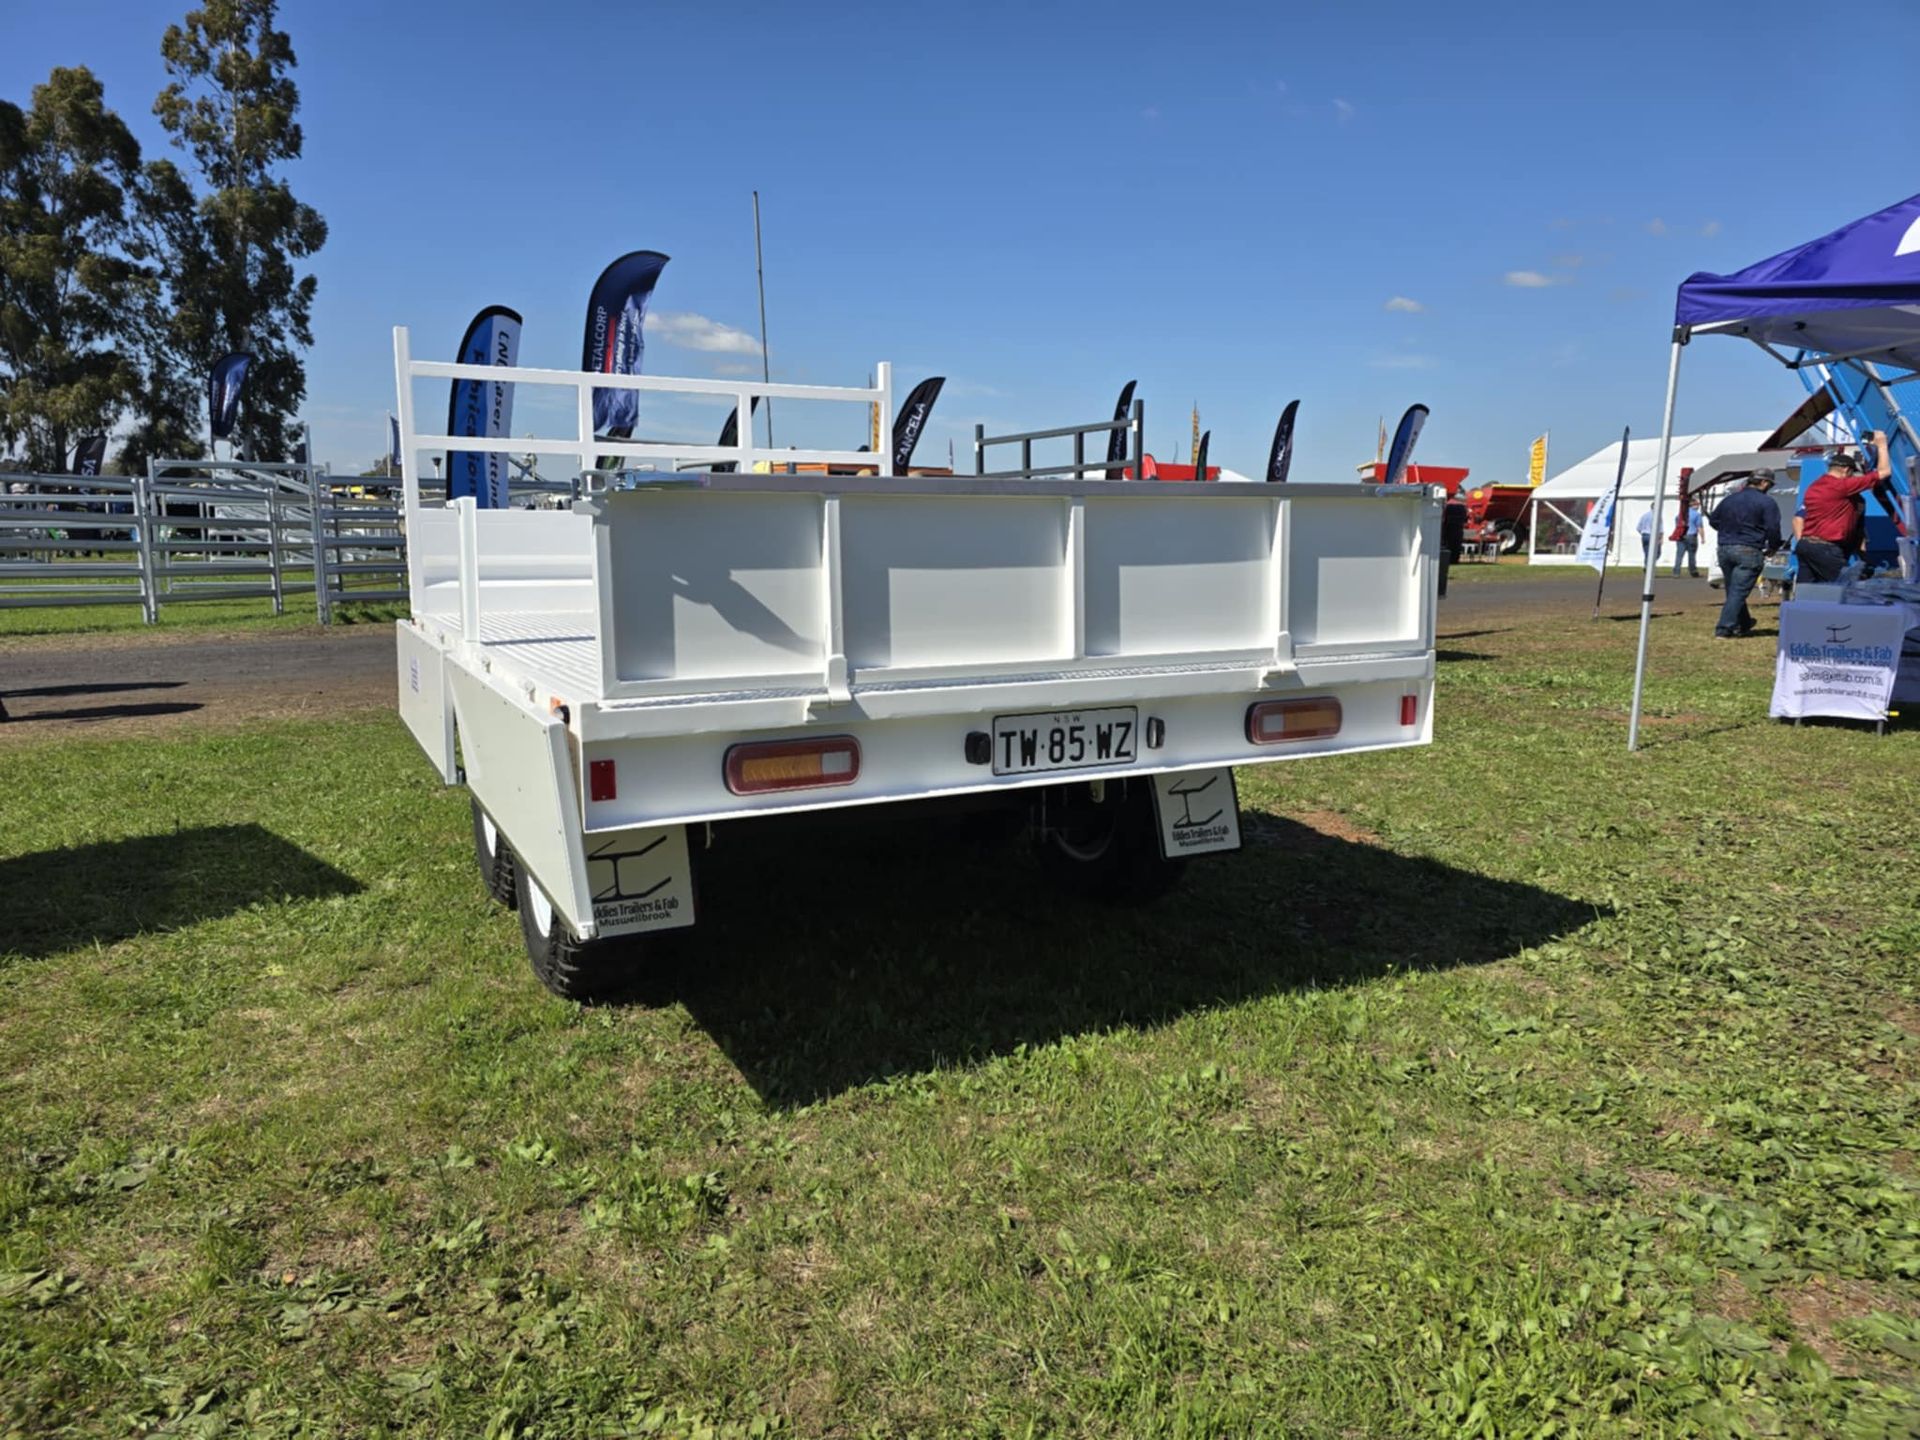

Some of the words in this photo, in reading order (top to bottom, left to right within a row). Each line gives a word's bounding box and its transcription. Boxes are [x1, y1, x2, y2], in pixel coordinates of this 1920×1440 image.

[592, 306, 607, 373] ETALCORP
[896, 403, 926, 465] CANCELA
[1874, 646, 1892, 661] Fab
[593, 904, 618, 919] ddies
[618, 900, 654, 916] Trailers
[654, 899, 662, 911] &
[663, 896, 679, 911] Fab
[600, 909, 671, 927] Muswellbrook
